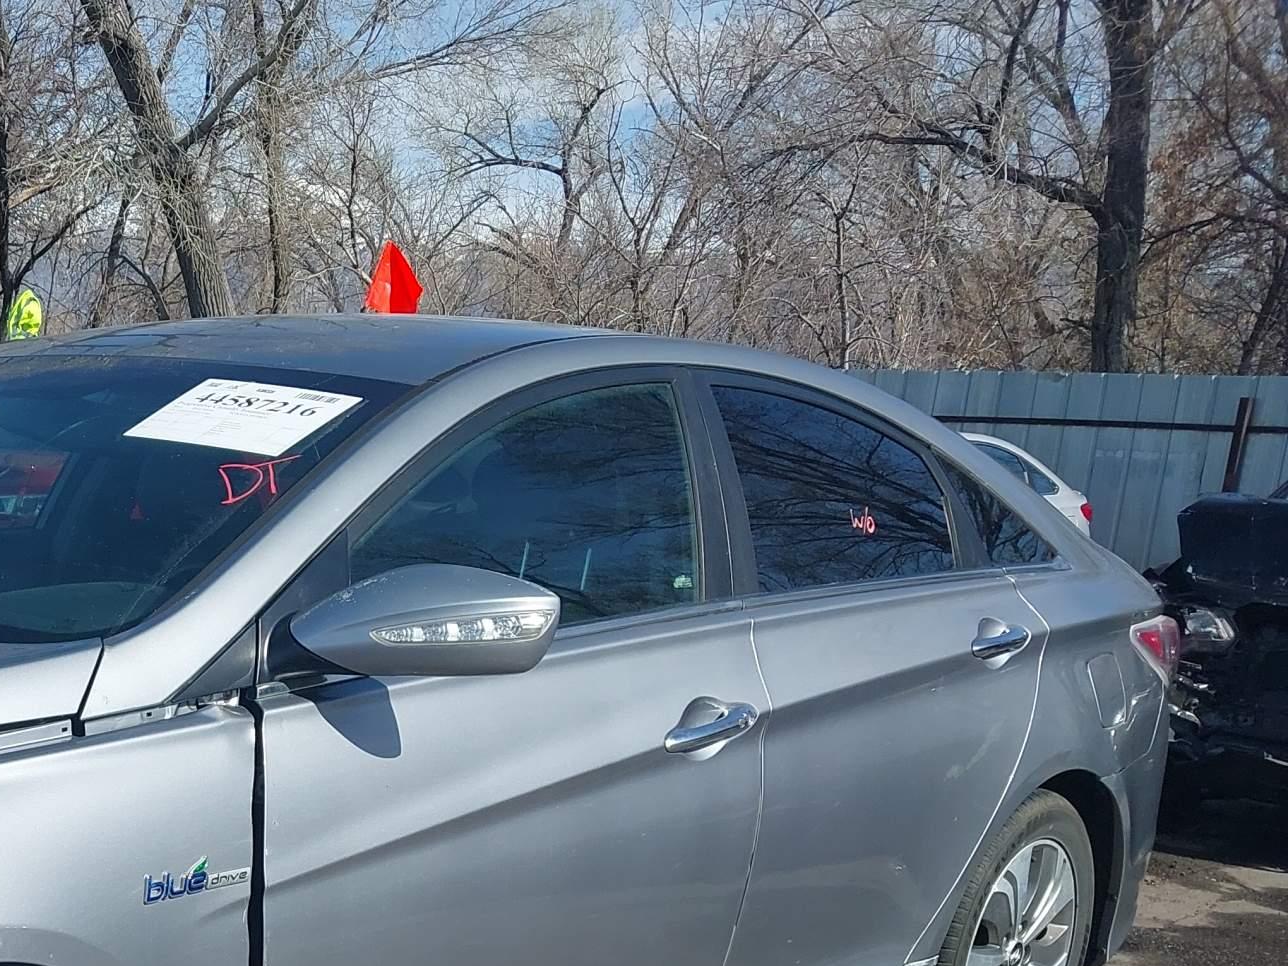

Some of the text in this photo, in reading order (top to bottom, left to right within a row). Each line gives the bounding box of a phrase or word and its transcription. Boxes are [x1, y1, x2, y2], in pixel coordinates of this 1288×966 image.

[196, 392, 324, 417] 44587216
[218, 455, 302, 505] DT
[143, 870, 248, 905] blue drive
